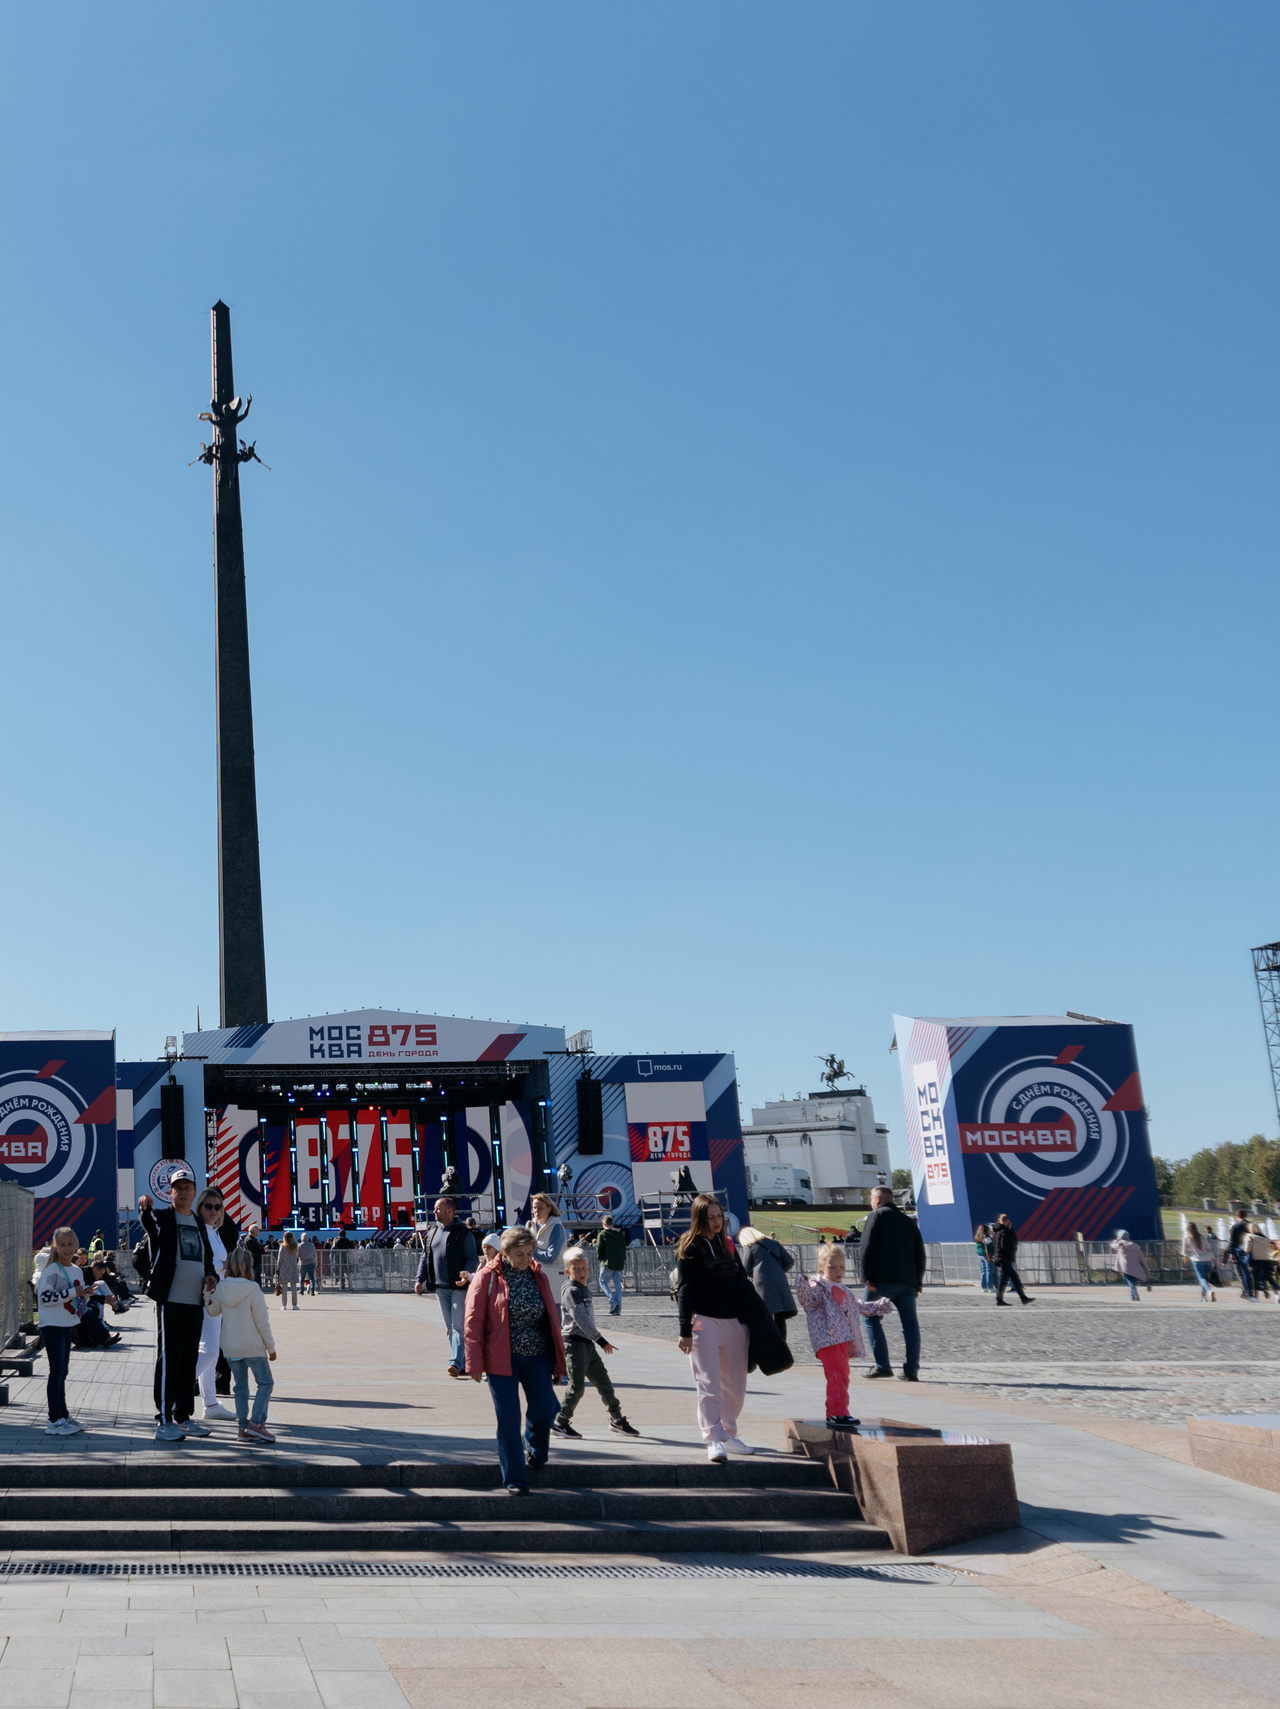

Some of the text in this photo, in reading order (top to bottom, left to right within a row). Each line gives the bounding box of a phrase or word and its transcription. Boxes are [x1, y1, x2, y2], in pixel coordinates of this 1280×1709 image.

[309, 1025, 361, 1041] МОС
[368, 1024, 437, 1046] 875
[310, 1043, 362, 1059] КВА
[368, 1050, 438, 1058] ДЕНЬ ГОРОДА
[1012, 1084, 1100, 1140] С ДНЁМ РОЖДЕНИЯ
[0, 1097, 30, 1120] ДНЁМ
[31, 1099, 69, 1152] РОЖДЕНИЯ
[648, 1125, 691, 1152] 875
[965, 1129, 1072, 1146] МОСКВА
[296, 1122, 413, 1204] 875
[927, 1162, 949, 1179] 875
